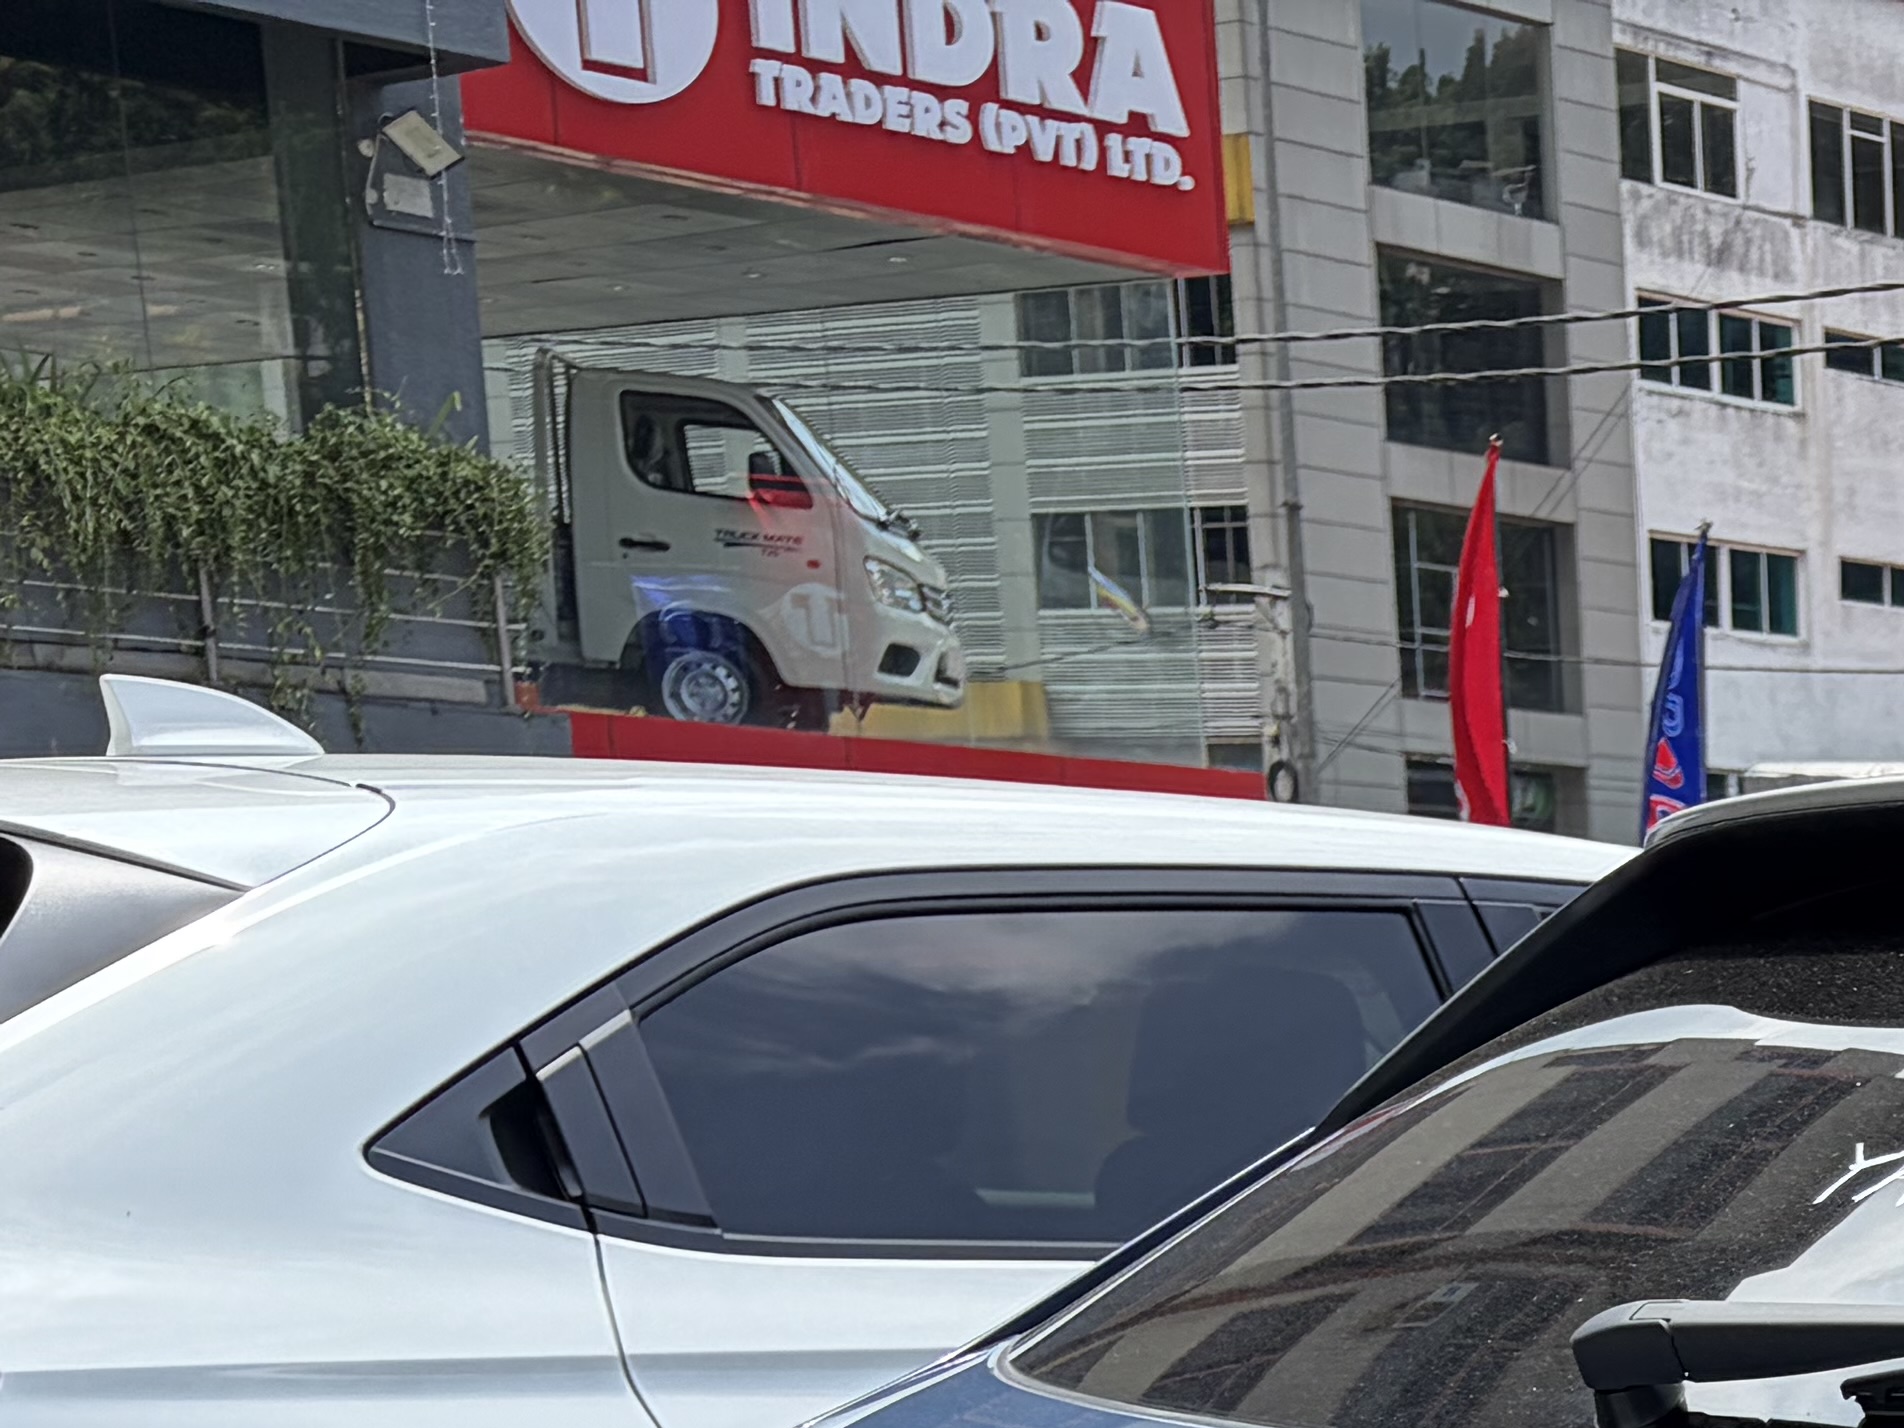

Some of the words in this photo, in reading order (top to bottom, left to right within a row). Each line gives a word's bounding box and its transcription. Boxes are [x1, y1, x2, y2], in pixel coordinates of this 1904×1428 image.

[751, 59, 973, 146] TRADERS
[979, 102, 1099, 172] (PVT)
[1106, 133, 1196, 191] LTD.
